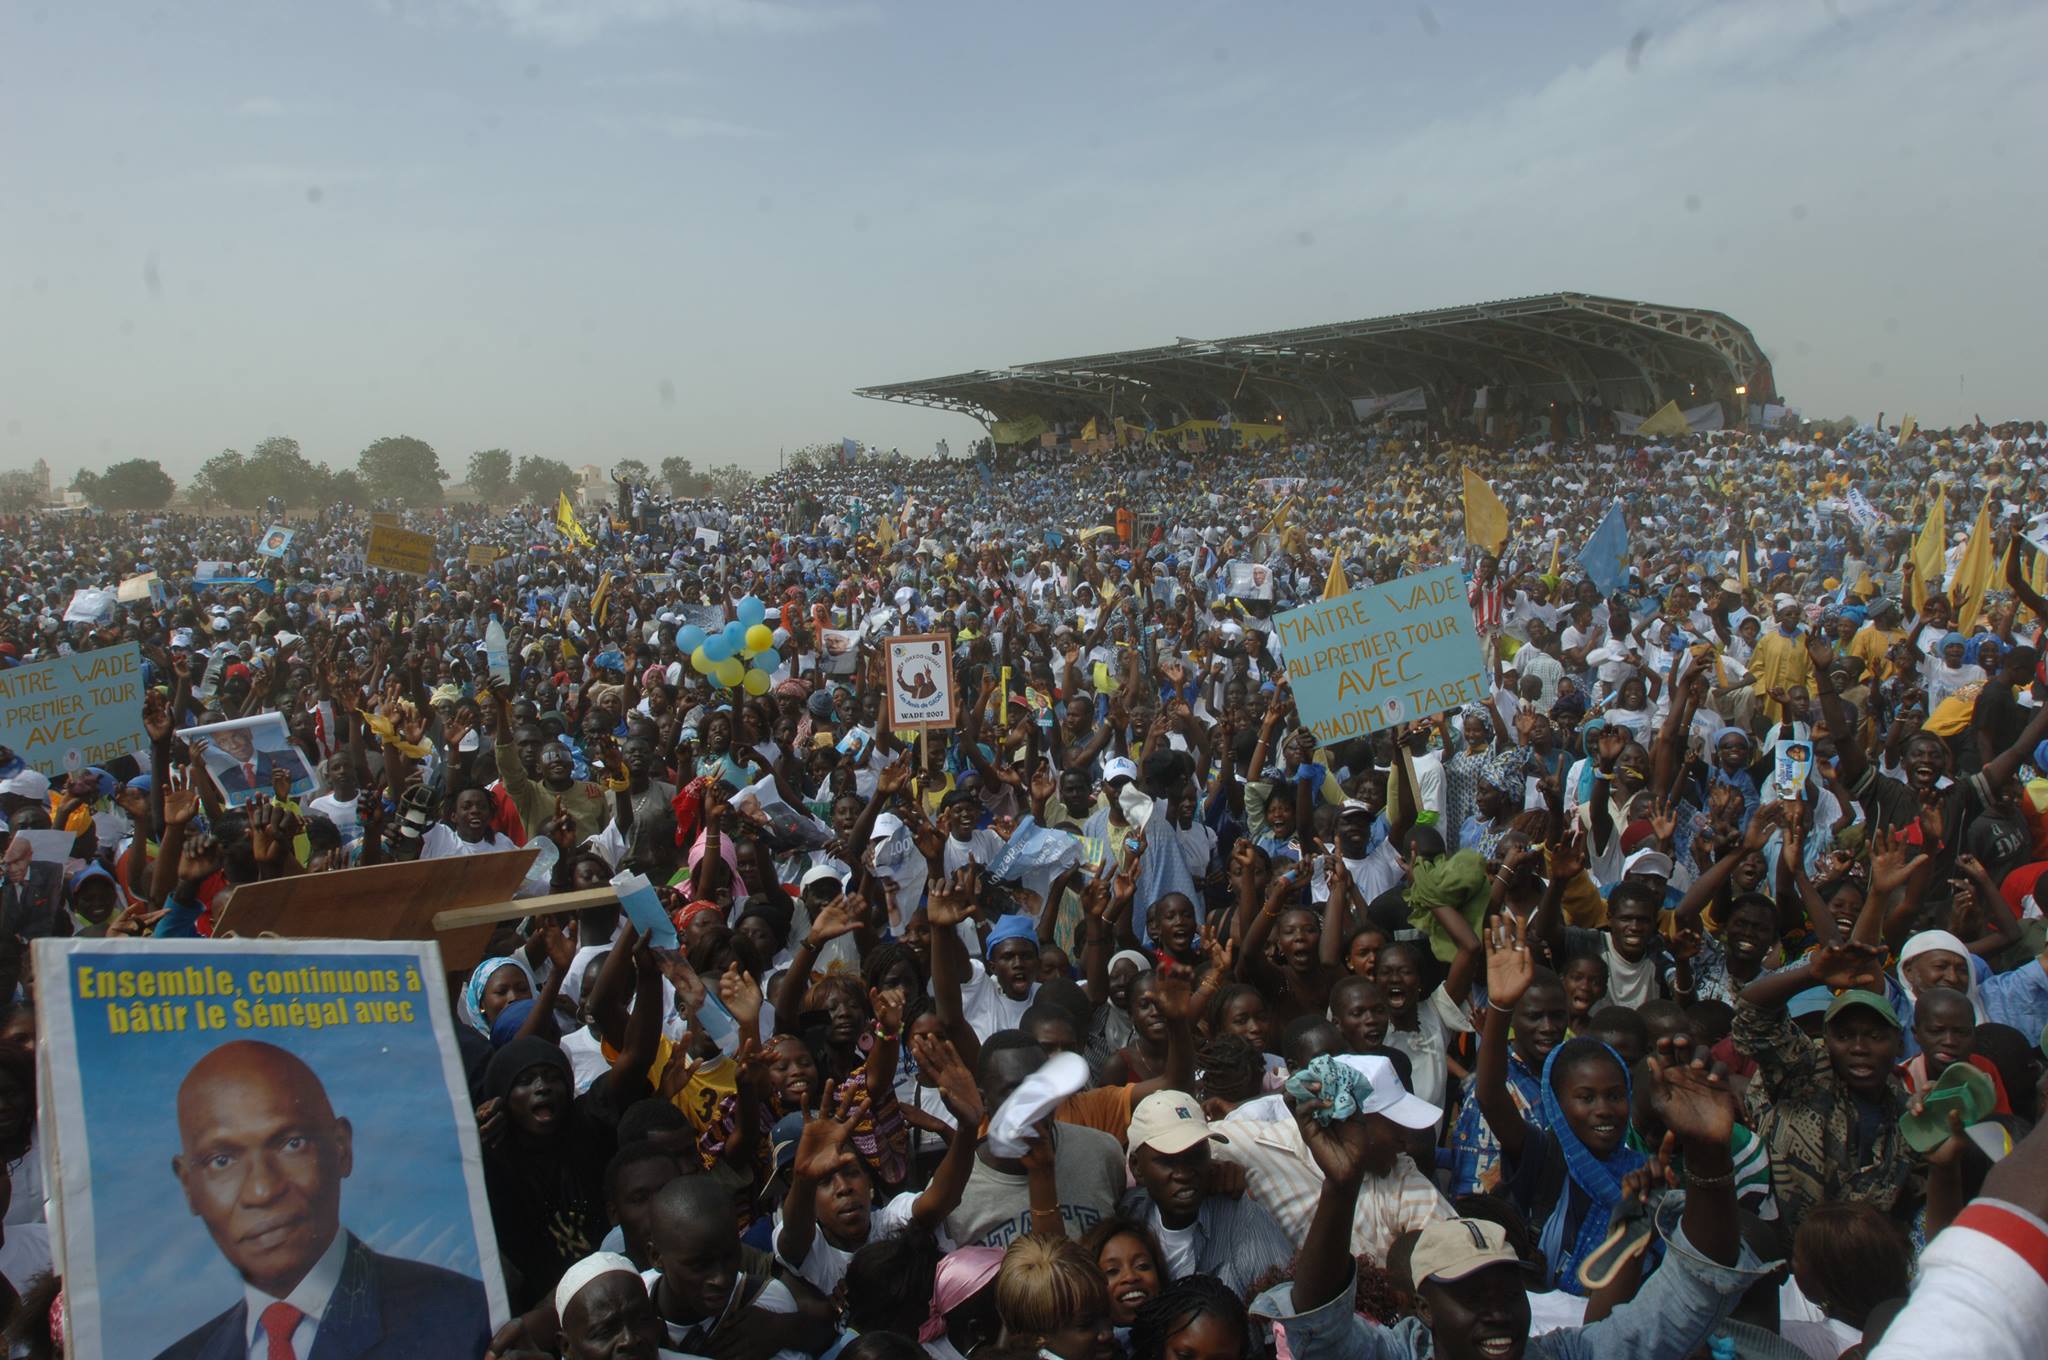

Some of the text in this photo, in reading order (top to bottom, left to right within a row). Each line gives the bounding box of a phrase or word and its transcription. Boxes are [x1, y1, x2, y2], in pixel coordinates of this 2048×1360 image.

[1384, 575, 1461, 613] WADE
[1288, 655, 1311, 680] AU
[1402, 615, 1461, 645] TOUR
[71, 651, 139, 684] WADE
[1337, 651, 1424, 704] AVEC
[88, 682, 137, 706] TOUR
[1405, 672, 1485, 714] TABET
[25, 712, 101, 751] AVEC
[901, 711, 925, 719] WADE
[82, 732, 141, 764] TABET
[77, 964, 422, 999] Ensemble, continuons à
[106, 997, 416, 1034] bâtir le Sénégal avec
